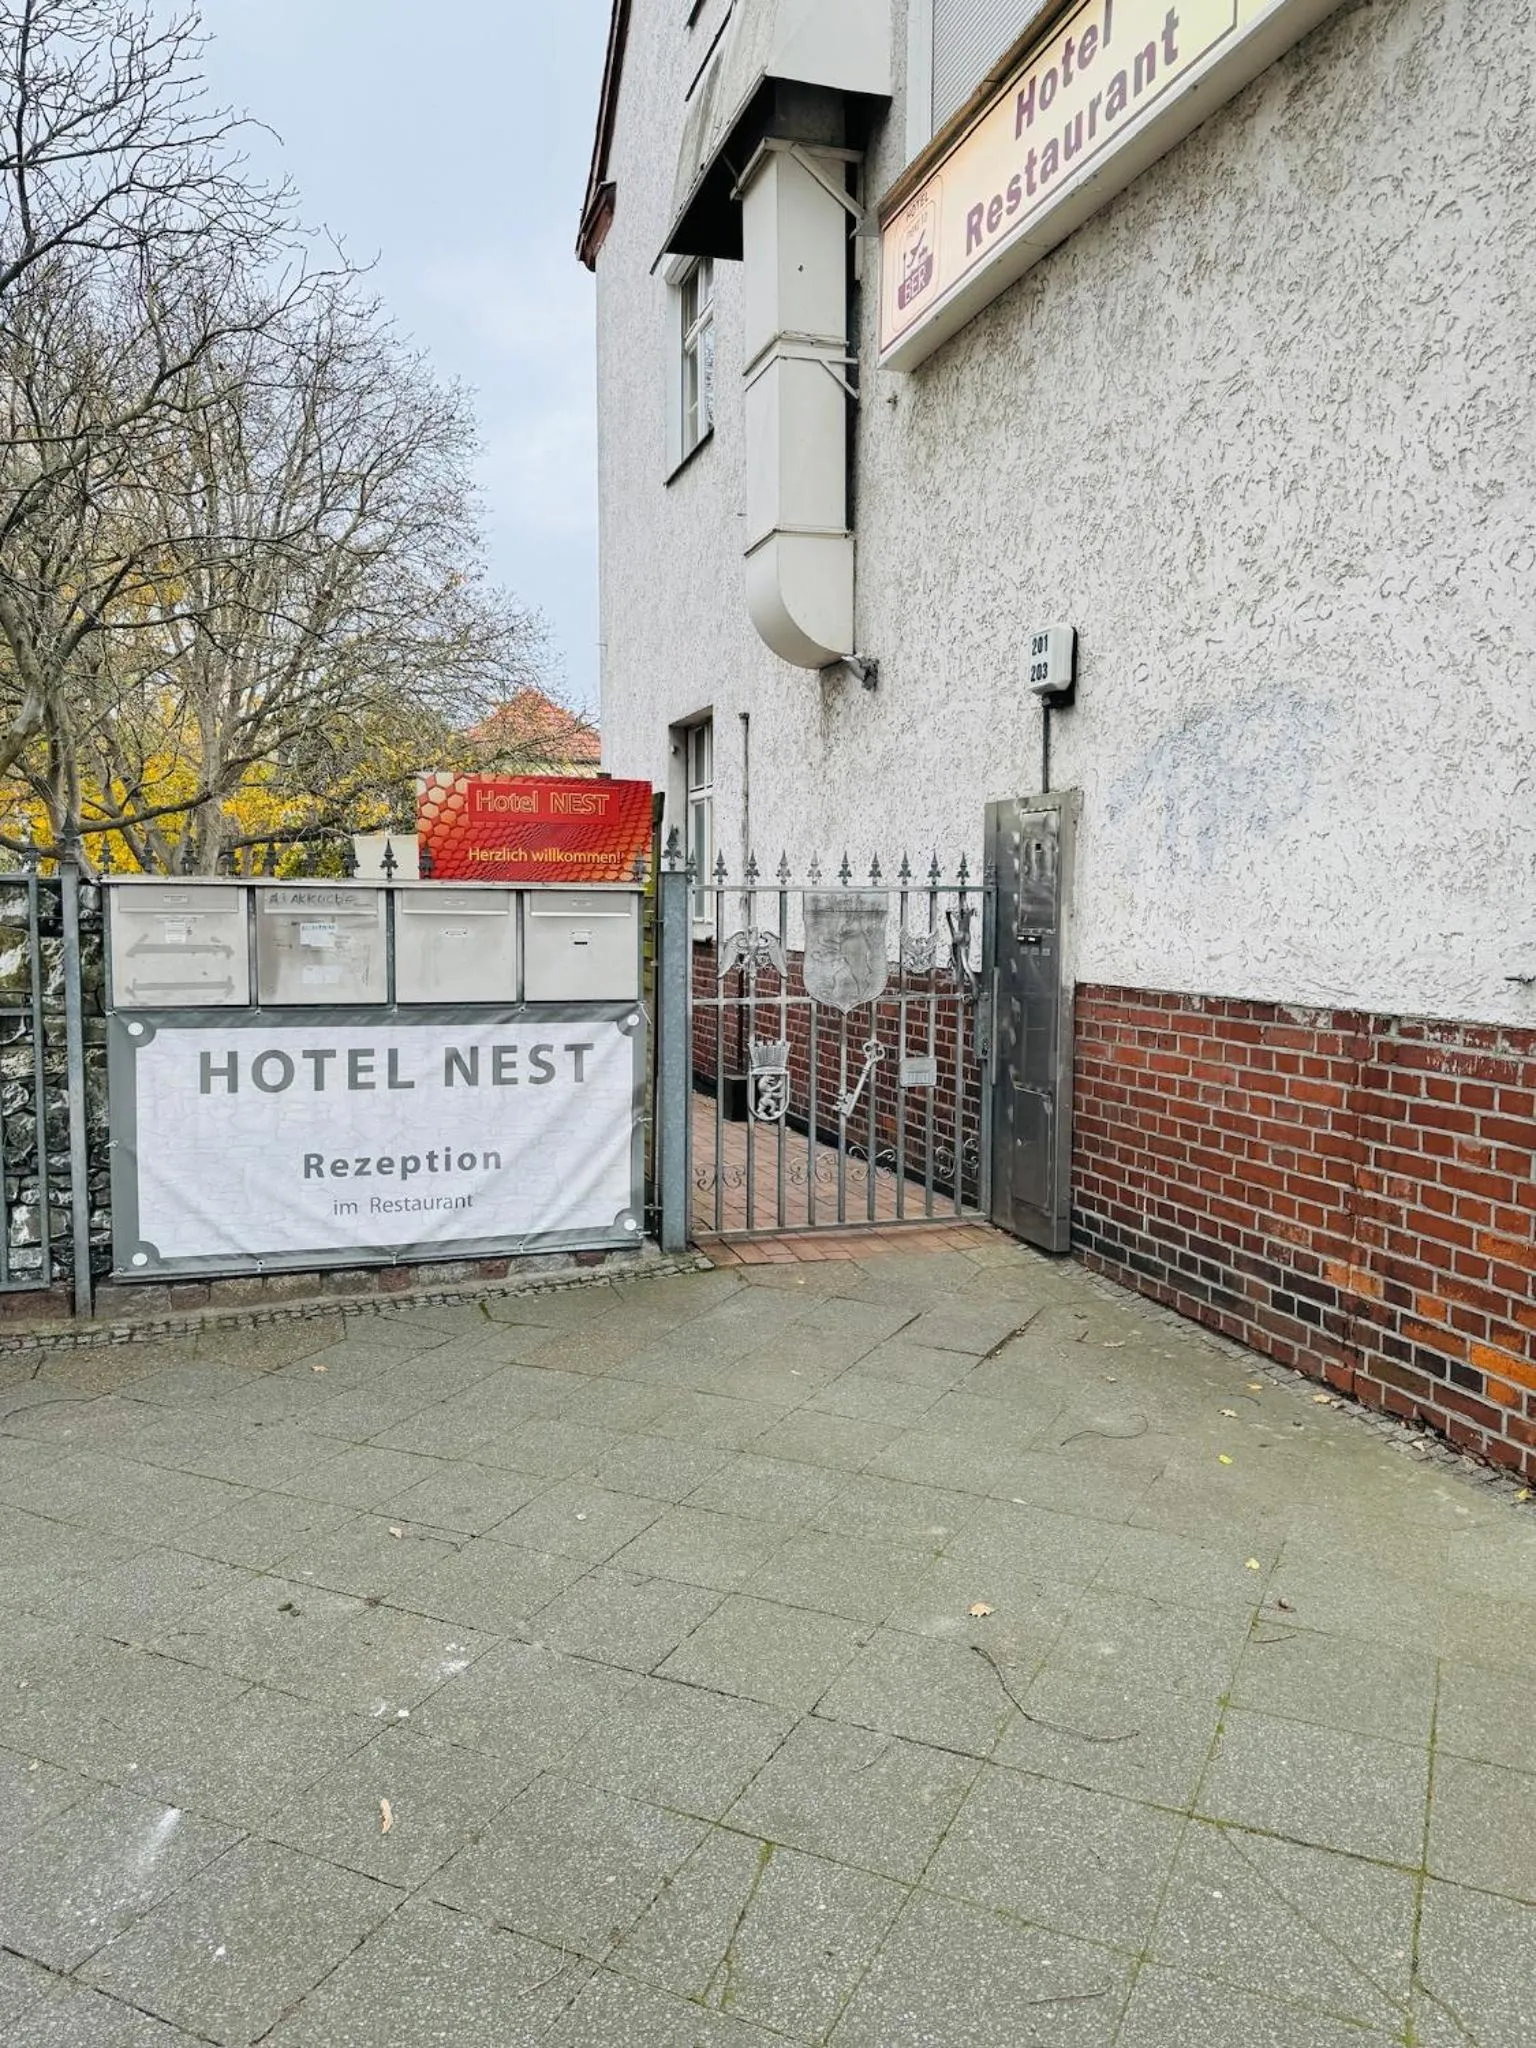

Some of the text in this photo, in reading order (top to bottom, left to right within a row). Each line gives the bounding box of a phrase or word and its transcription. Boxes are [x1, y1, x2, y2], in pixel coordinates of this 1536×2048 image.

[1014, 0, 1113, 140] Hotel
[965, 6, 1179, 257] Restaurant
[905, 191, 929, 222] HOTEL
[904, 265, 928, 304] BER
[1031, 634, 1049, 656] 201
[1030, 662, 1048, 682] 203
[475, 790, 610, 816] Hotel NEST
[468, 847, 622, 864] Herzlich willkommen!
[199, 1042, 595, 1094] HOTEL NEST
[303, 1146, 502, 1181] Rezeption
[333, 1194, 474, 1215] im Restaurant
